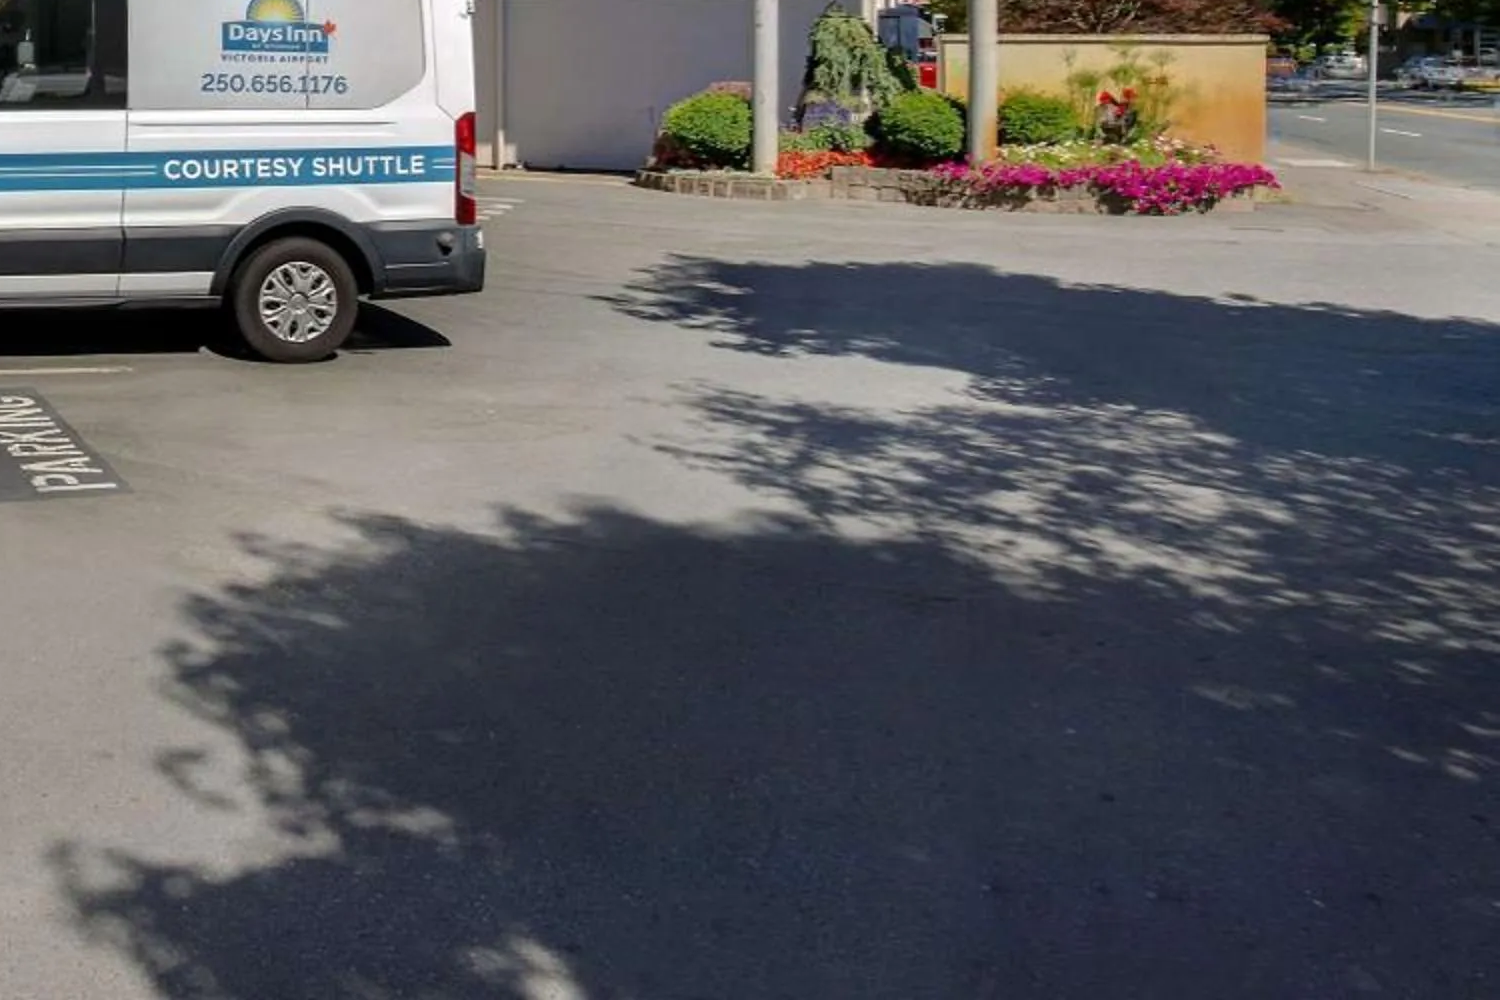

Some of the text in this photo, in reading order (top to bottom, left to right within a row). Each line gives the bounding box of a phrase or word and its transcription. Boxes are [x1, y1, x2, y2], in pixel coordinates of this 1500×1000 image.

[228, 23, 323, 42] Days Inn
[201, 73, 348, 94] 250.656.1176
[163, 154, 425, 180] COURTESY SHUTTLE
